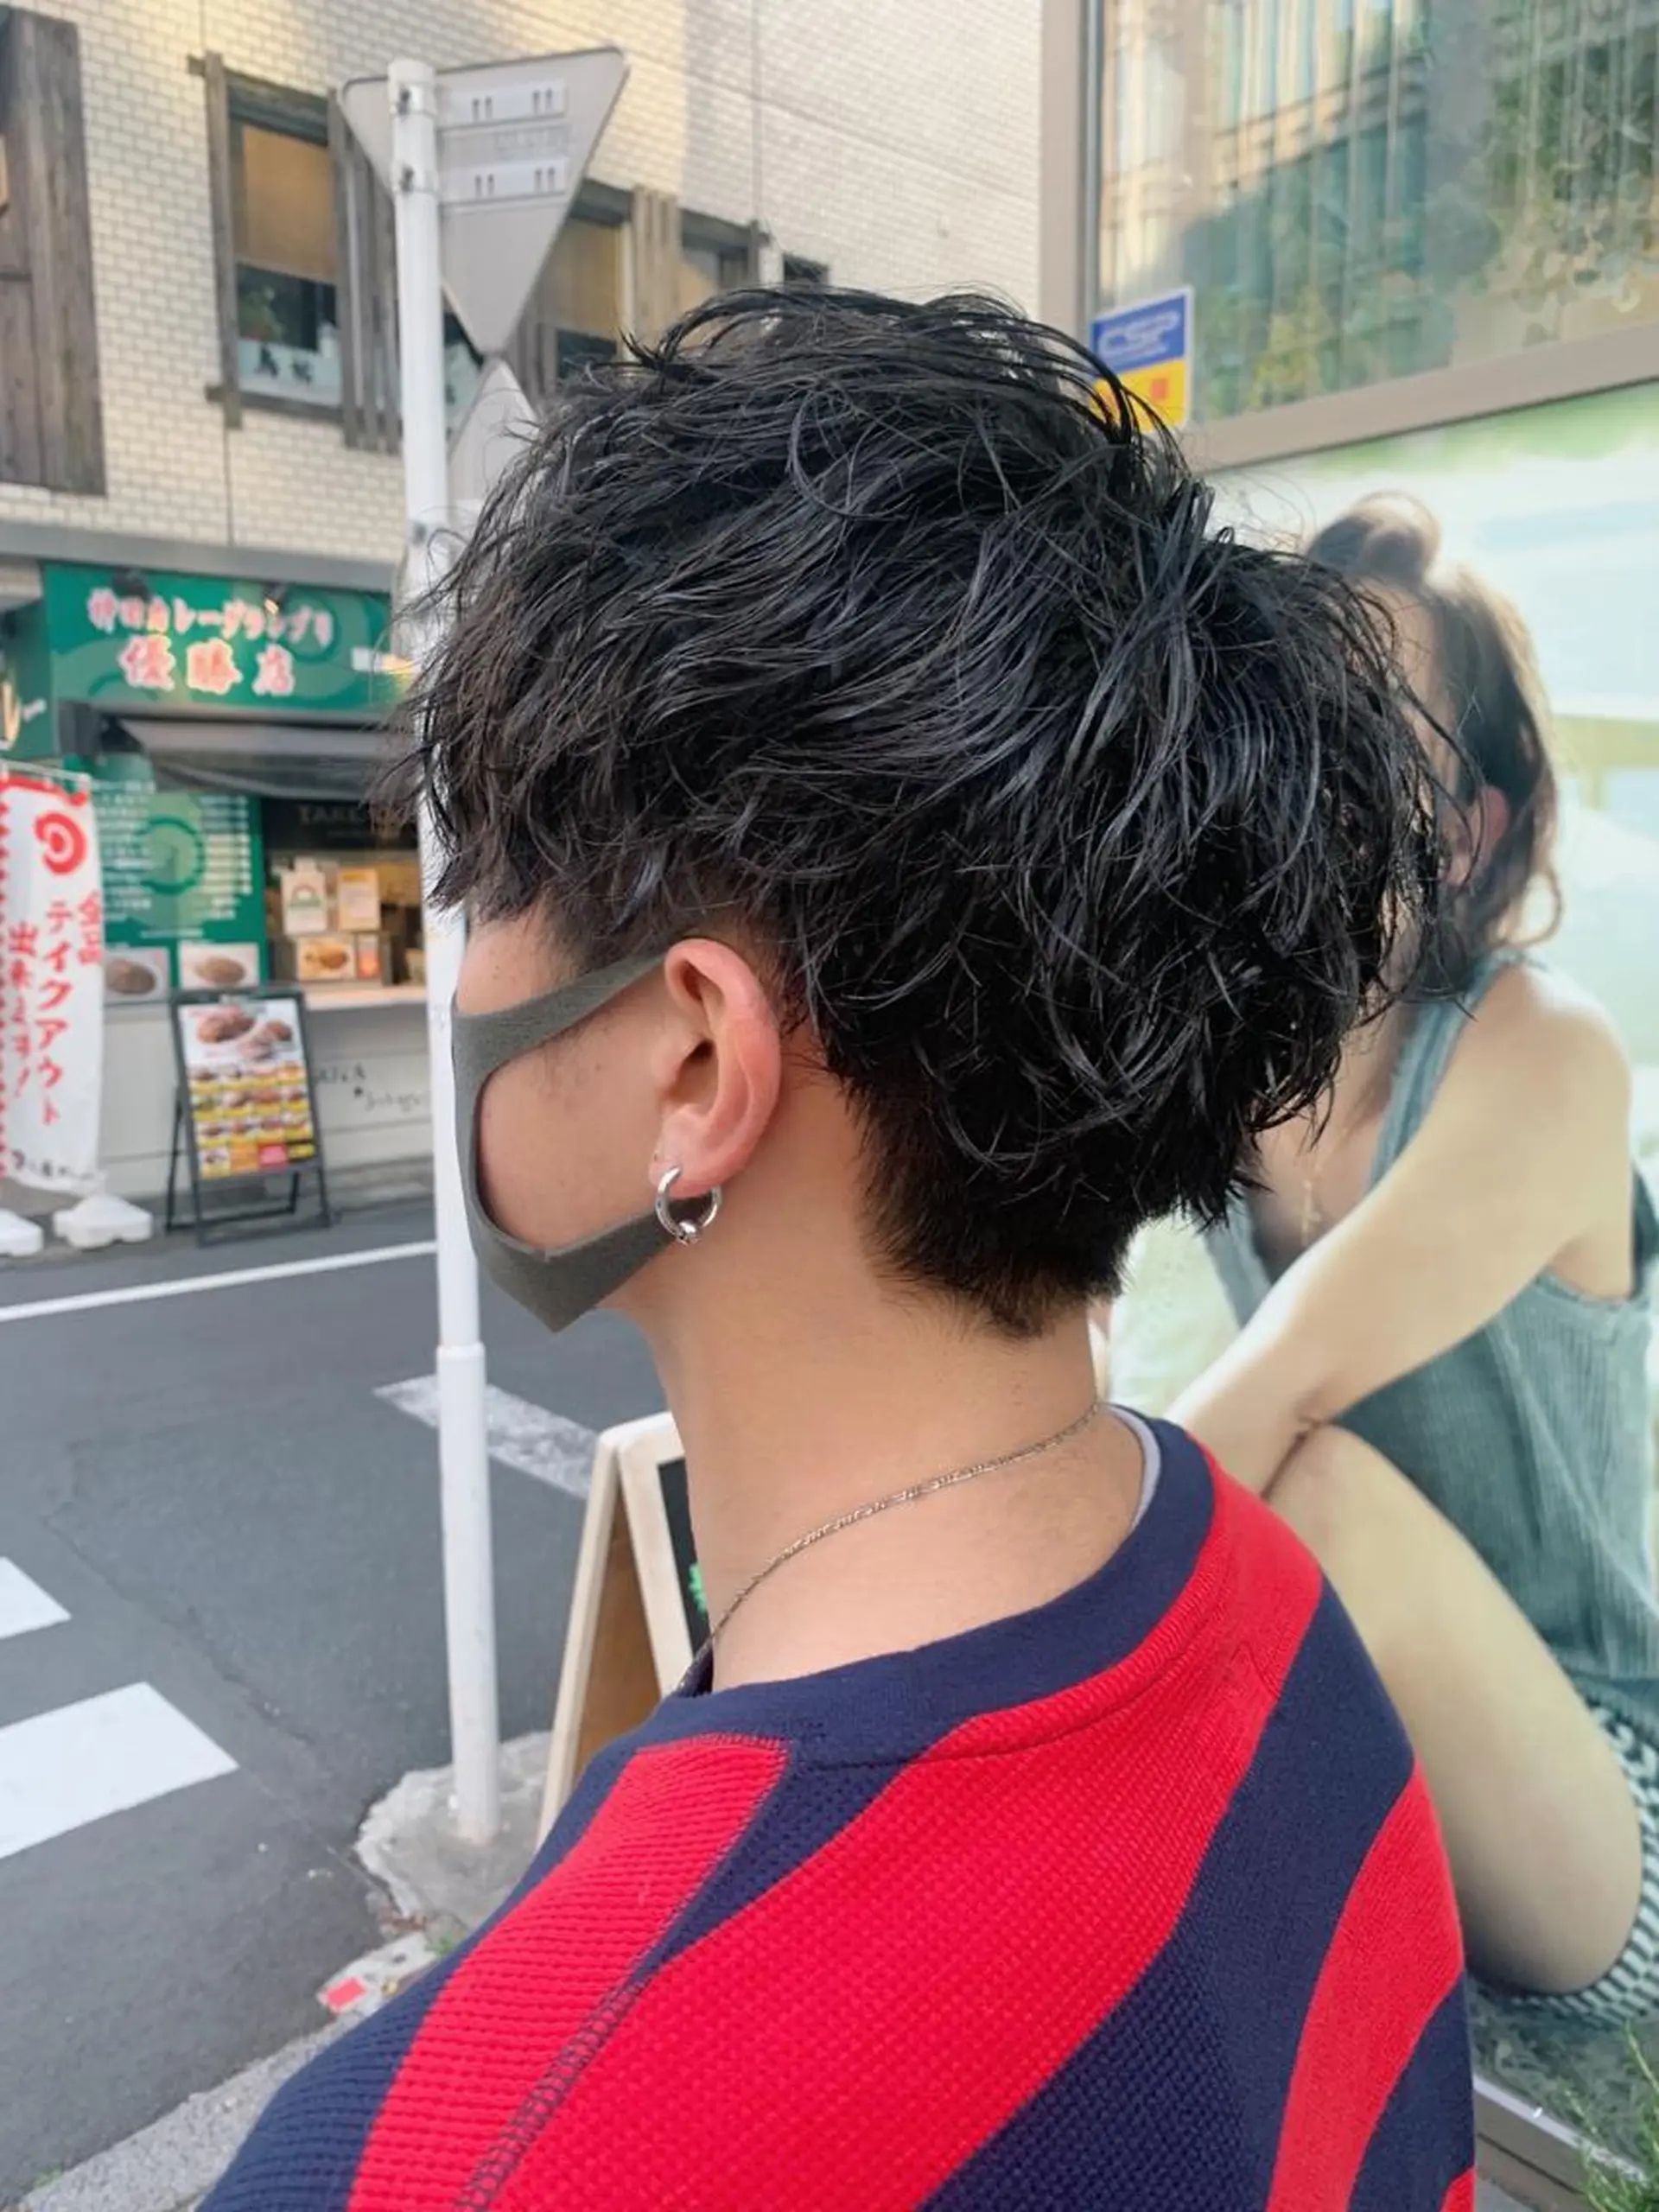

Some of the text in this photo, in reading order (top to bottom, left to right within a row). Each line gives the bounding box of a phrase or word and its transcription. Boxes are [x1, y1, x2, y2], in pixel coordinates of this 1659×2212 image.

[35, 899, 73, 1127] テイクアウト
